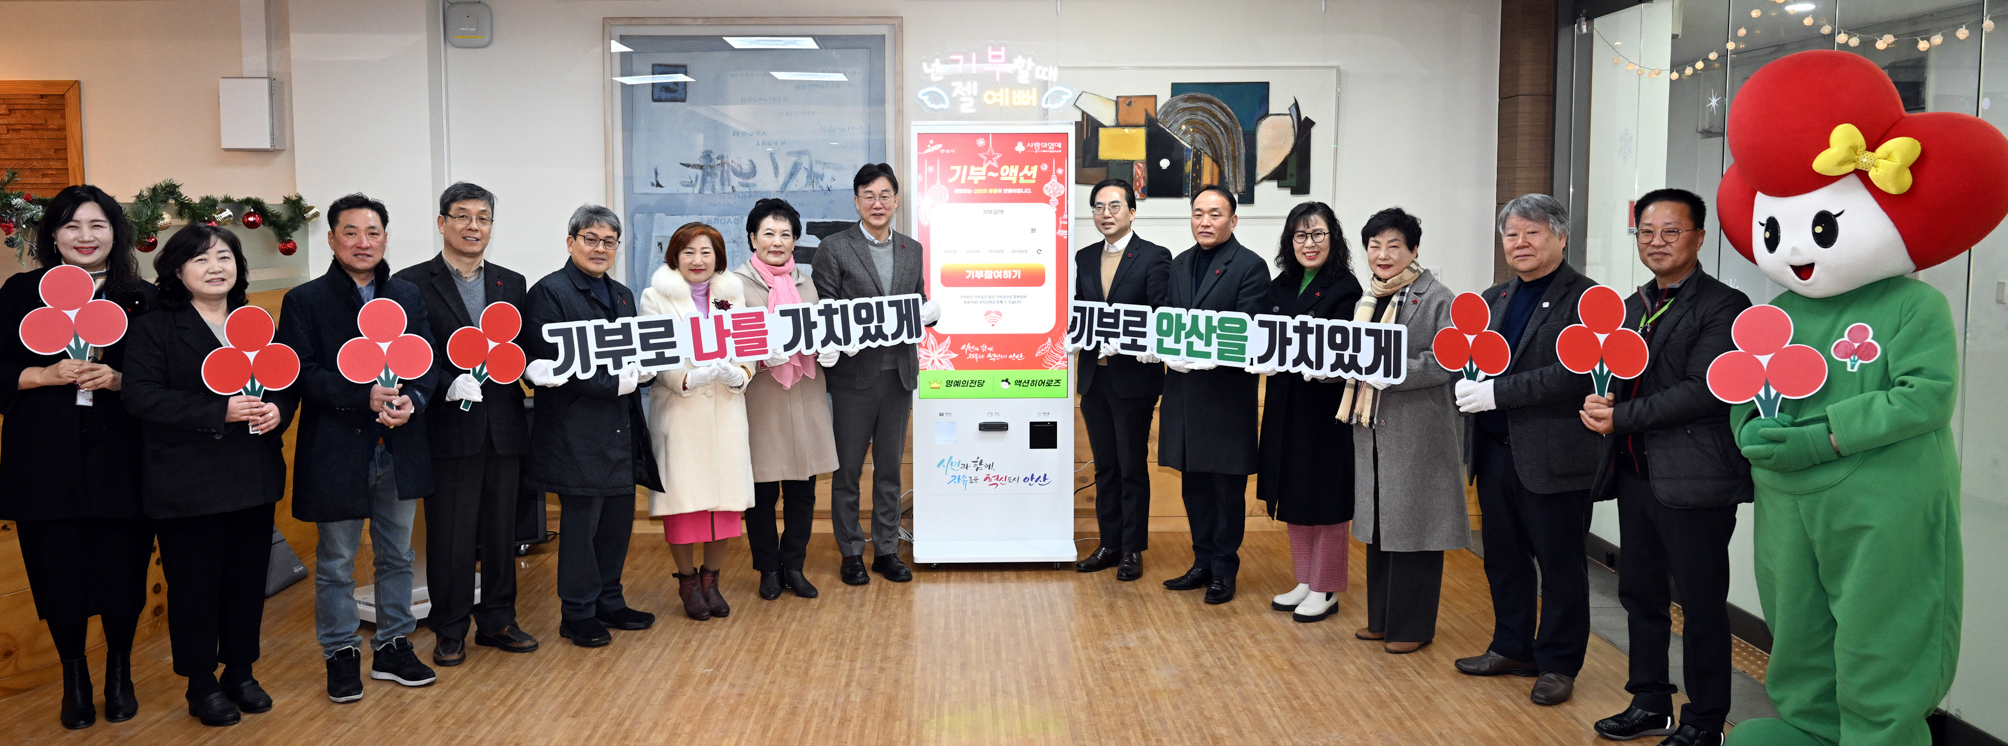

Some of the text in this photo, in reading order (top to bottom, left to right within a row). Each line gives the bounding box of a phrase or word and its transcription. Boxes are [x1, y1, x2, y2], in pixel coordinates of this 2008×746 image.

[922, 58, 944, 82] 넌
[951, 81, 1037, 113] 젤 예뻐
[1026, 142, 1062, 151] 사랑의열매
[948, 165, 1038, 184] 기부~액션
[965, 269, 1021, 279] 기부참여하기
[547, 298, 922, 376] 기부로 나를 가치있게
[1071, 306, 1402, 379] 기부로 안산을 가치있게
[1014, 379, 1061, 387] 액션히어로즈
[936, 455, 971, 475] 시민과
[947, 473, 1052, 490] 자유로운 혁신도시 안산
